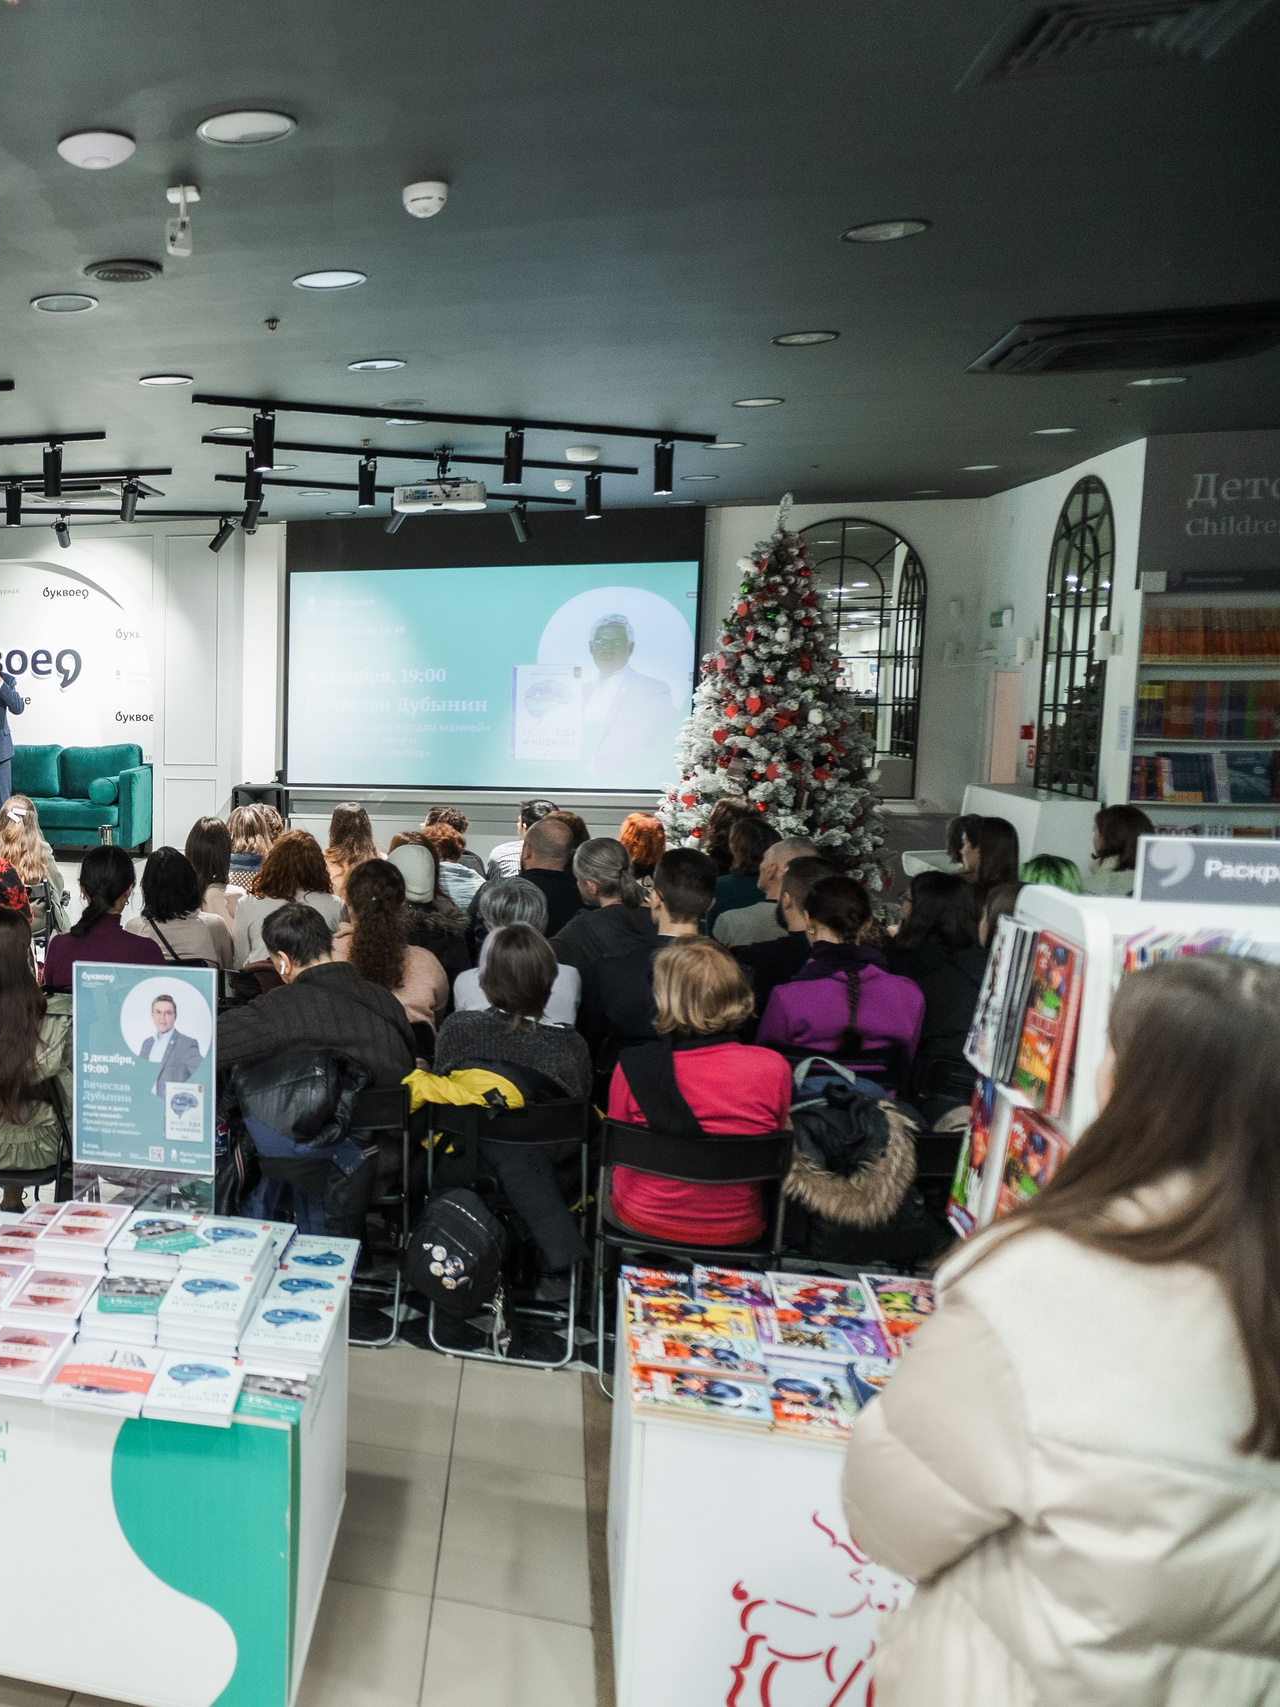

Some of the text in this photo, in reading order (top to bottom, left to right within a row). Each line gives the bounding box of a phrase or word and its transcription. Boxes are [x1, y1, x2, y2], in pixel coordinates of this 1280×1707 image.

[1185, 515, 1279, 536] Childre
[43, 587, 89, 600] буквоед
[400, 667, 447, 684] 19:00
[395, 696, 488, 716] Дубынин
[83, 1051, 136, 1067] 3 декабря,
[82, 1063, 109, 1075] 19:00
